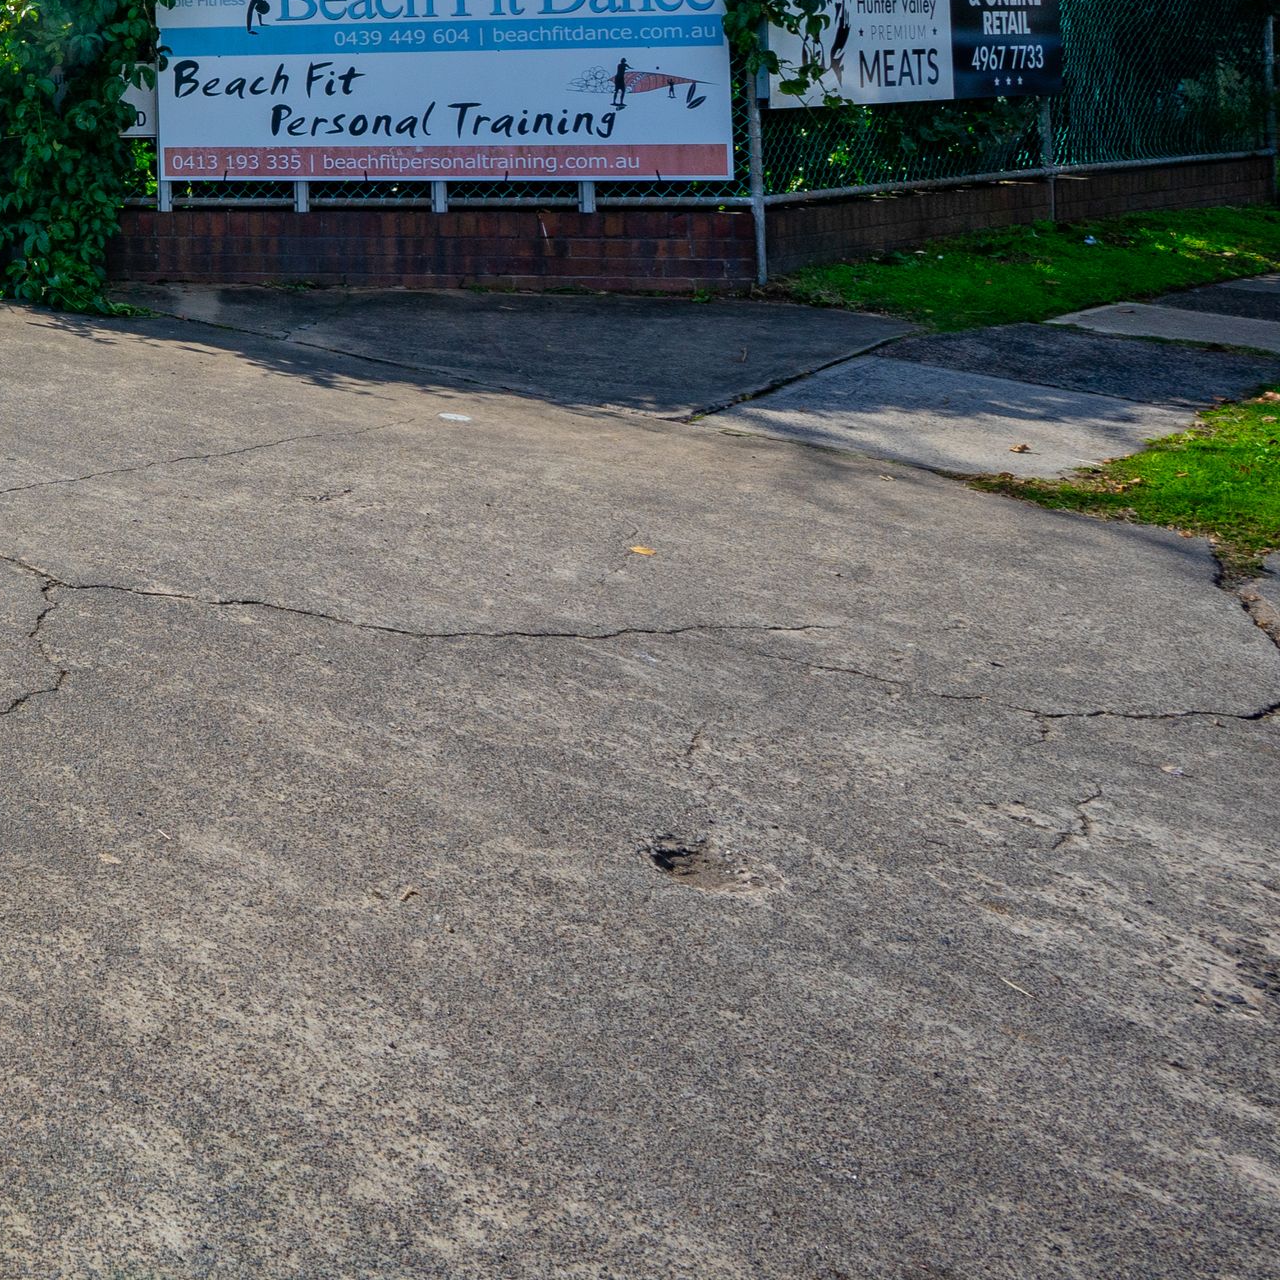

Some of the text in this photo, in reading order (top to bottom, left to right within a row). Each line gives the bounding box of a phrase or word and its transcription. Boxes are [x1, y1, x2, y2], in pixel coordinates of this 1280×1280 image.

[334, 30, 382, 46] 0439
[389, 29, 425, 45] 449
[433, 28, 470, 44] 604
[493, 24, 716, 43] beachfitdance.com.au
[870, 24, 926, 41] PREMIUM
[982, 10, 1031, 35] RETAIL
[859, 48, 939, 89] MEATS
[972, 45, 1044, 71] 4967 7733
[173, 60, 366, 99] Beach Fit
[271, 101, 617, 139] Personal Training
[172, 155, 218, 170] 0413
[226, 155, 259, 169] 193
[266, 155, 301, 169] 335
[323, 153, 640, 173] beachfitpersonaltraining.com.au
